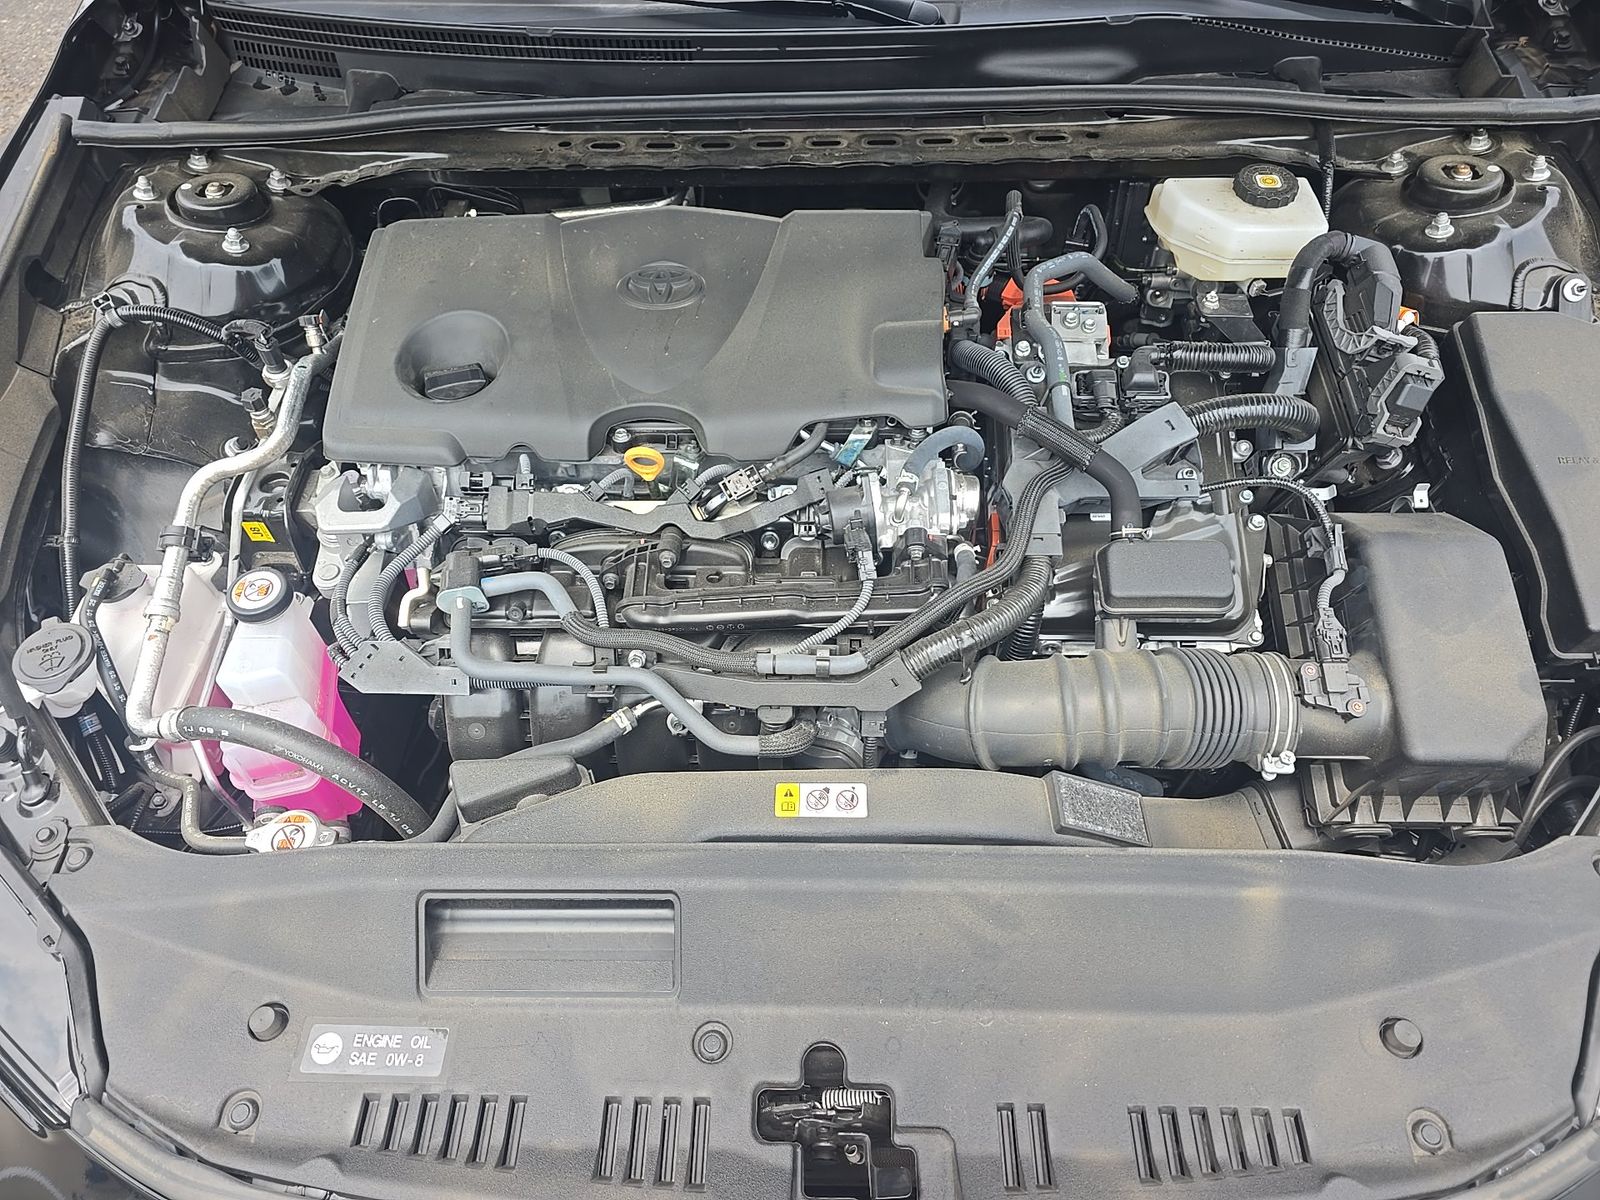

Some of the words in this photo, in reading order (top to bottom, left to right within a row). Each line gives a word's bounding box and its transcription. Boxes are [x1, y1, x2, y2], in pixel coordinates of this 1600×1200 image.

[26, 641, 53, 654] WASHER
[284, 748, 324, 772] YOKOHAMA
[331, 773, 369, 797] ACV17
[353, 1033, 403, 1049] ENGINE
[410, 1035, 432, 1049] OIL
[348, 1051, 378, 1066] SAE
[385, 1053, 424, 1067] 0W-8
